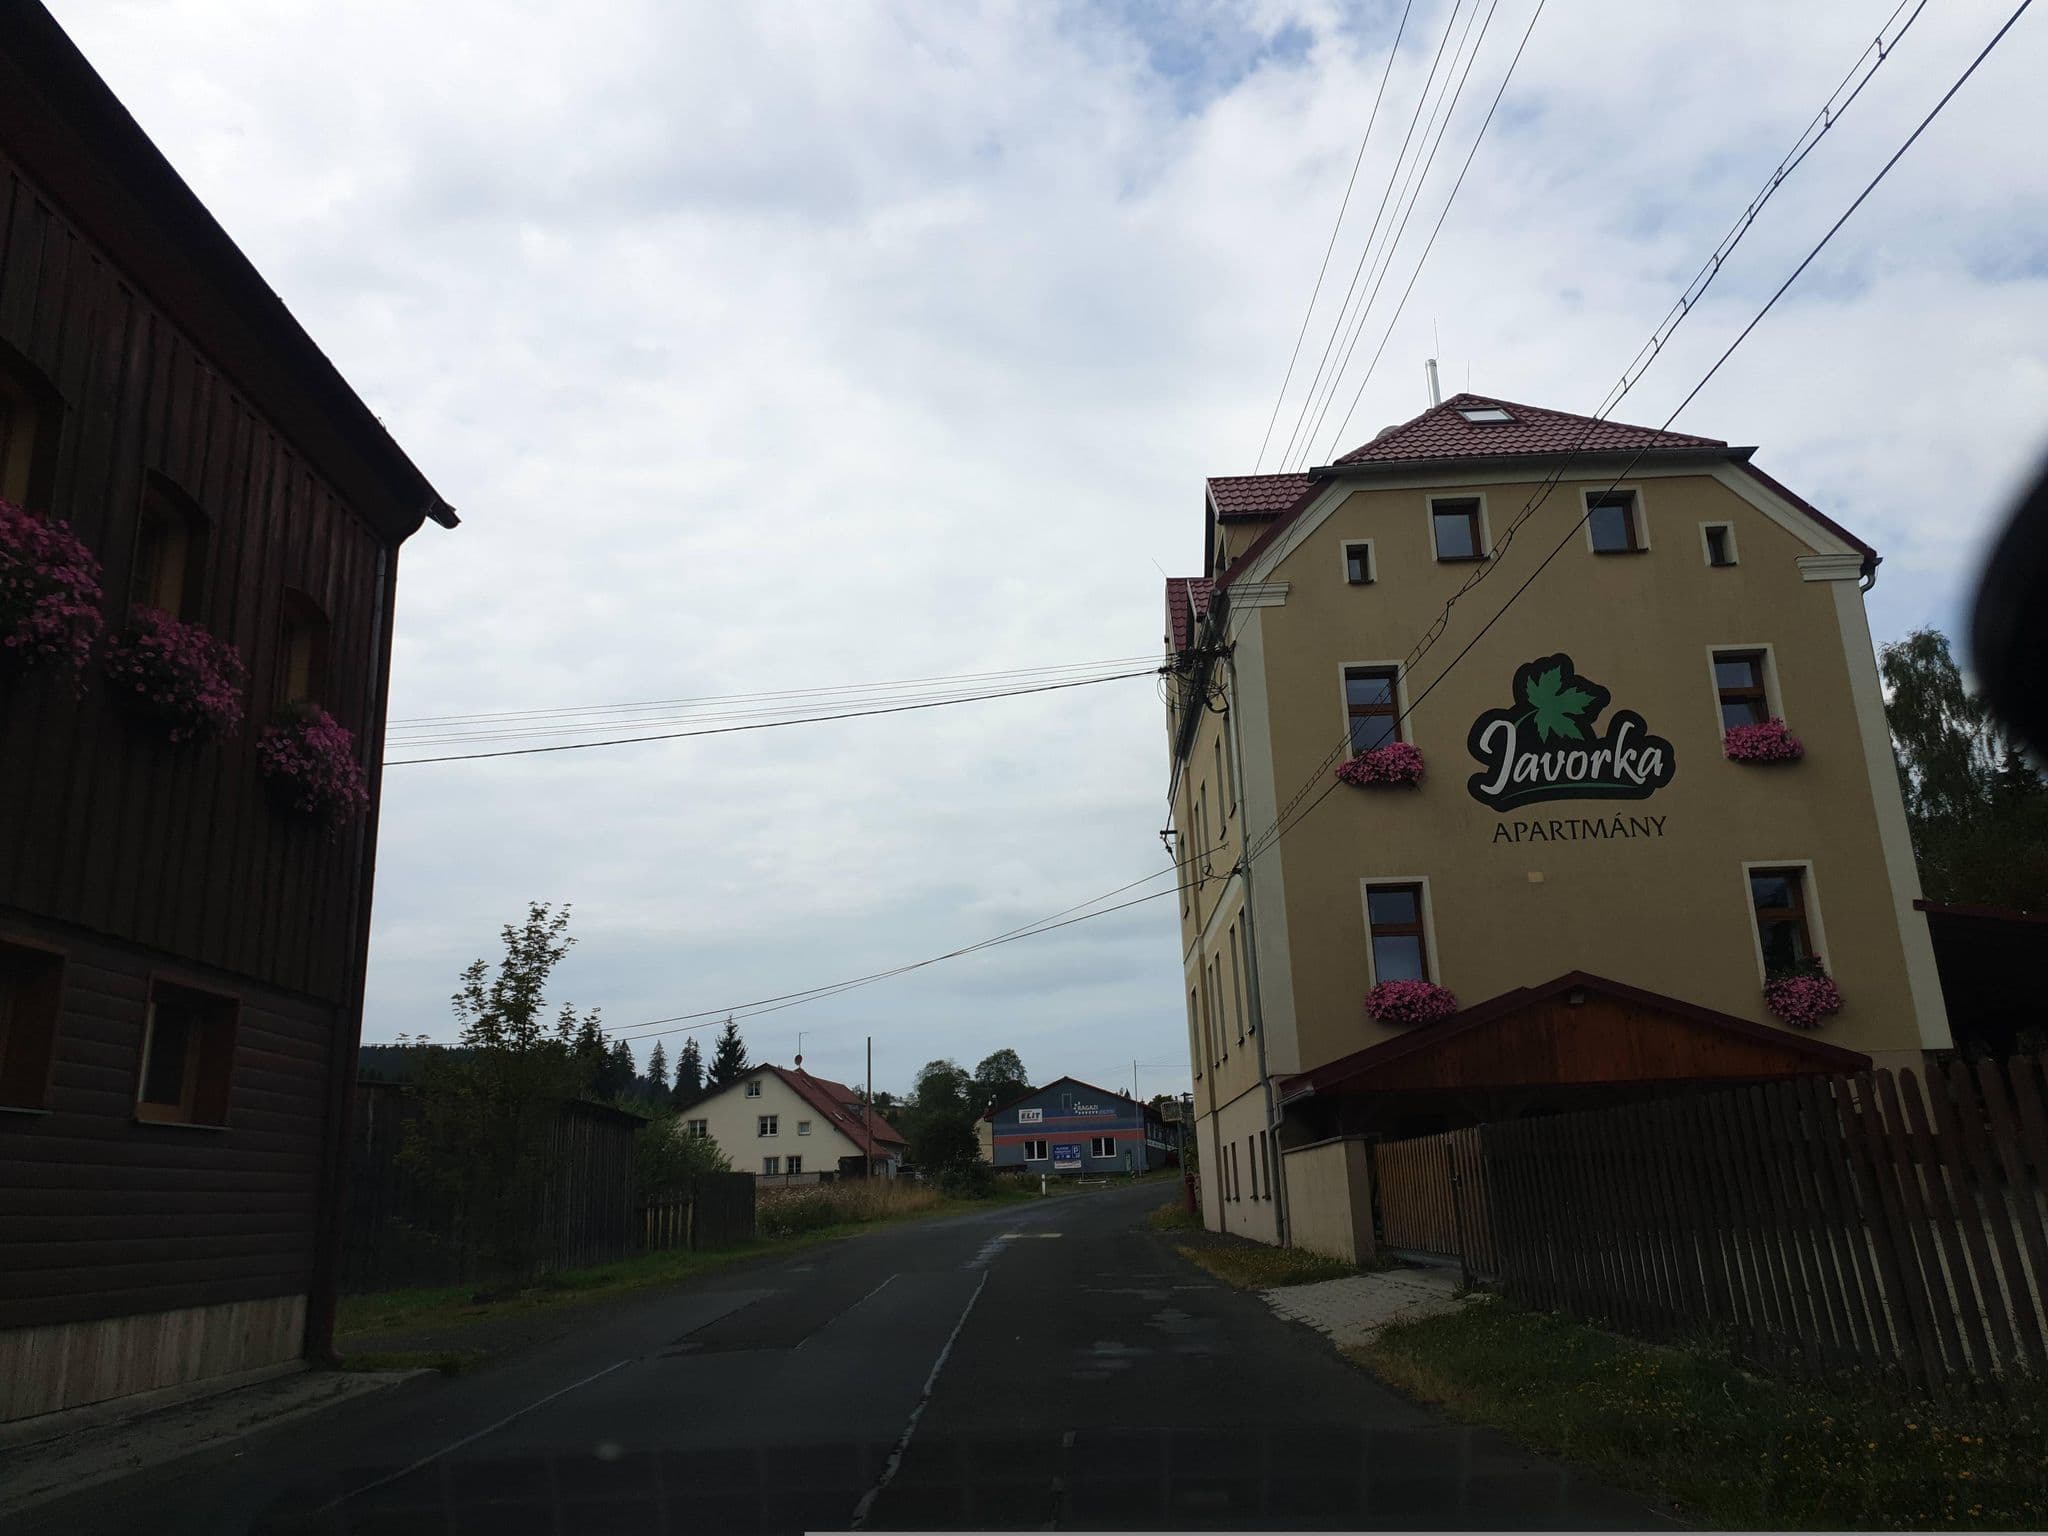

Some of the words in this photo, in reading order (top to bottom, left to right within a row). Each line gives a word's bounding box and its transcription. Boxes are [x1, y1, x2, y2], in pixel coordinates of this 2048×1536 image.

[1479, 719, 1664, 796] Javorka
[1492, 811, 1667, 843] APARTMÁNY
[1021, 1112, 1041, 1120] ELIT
